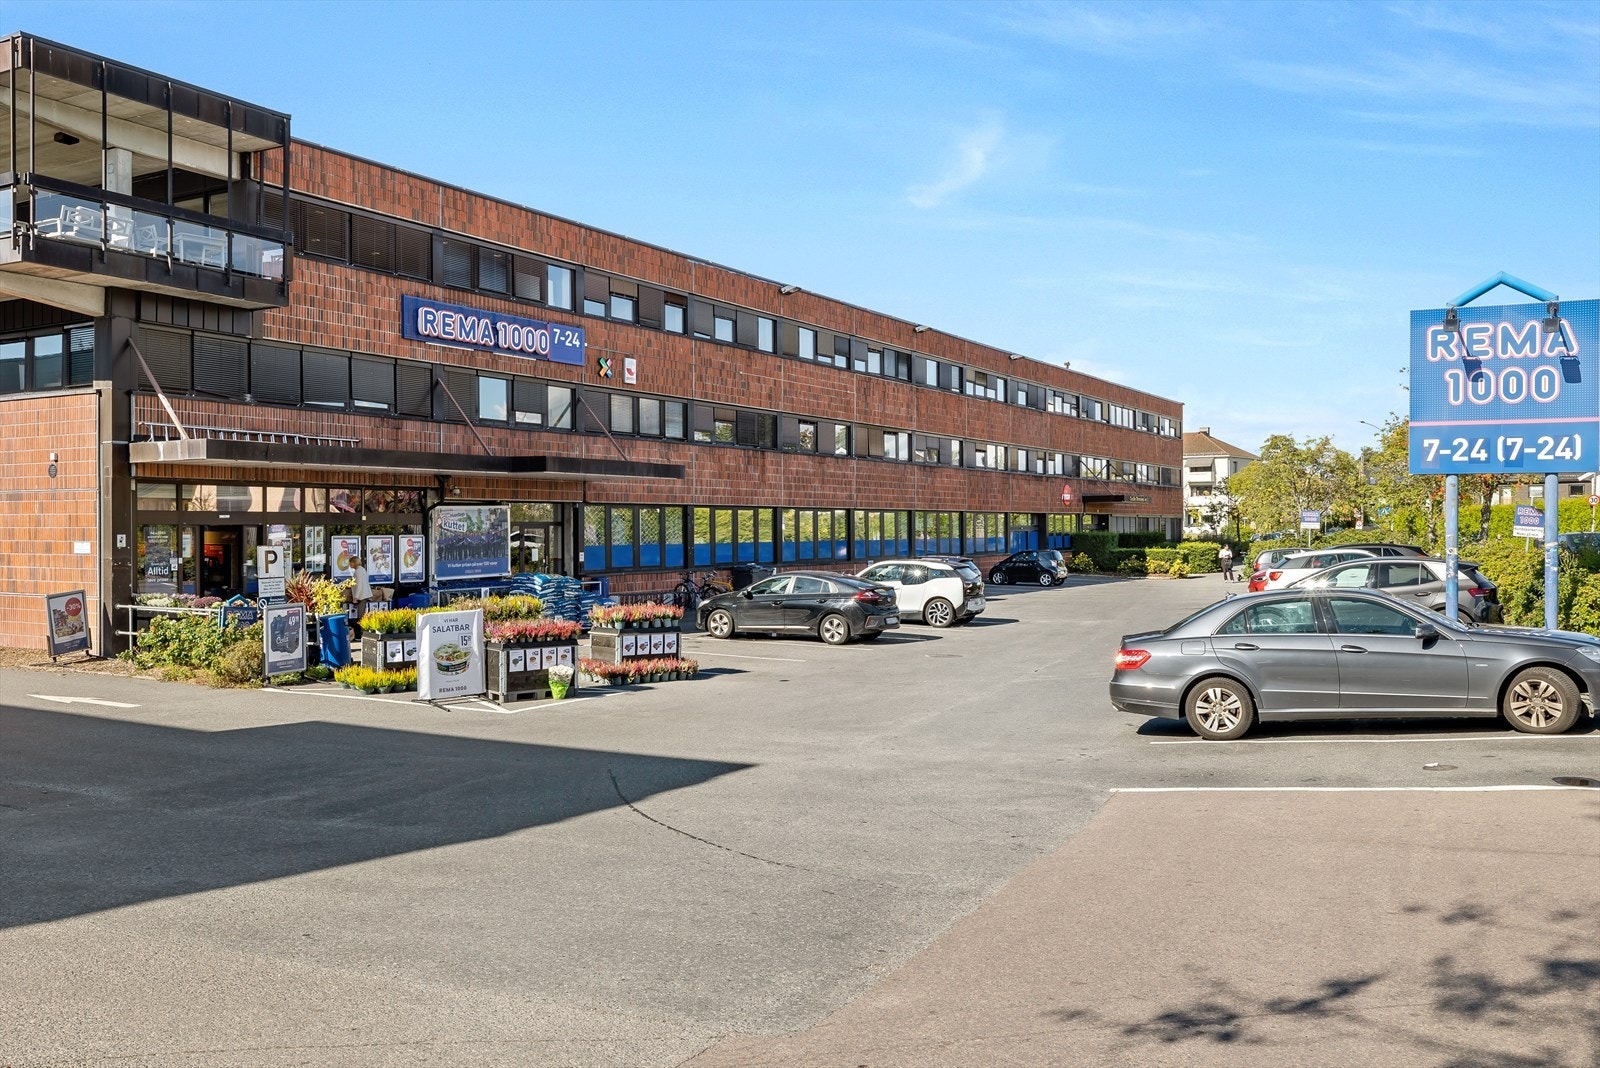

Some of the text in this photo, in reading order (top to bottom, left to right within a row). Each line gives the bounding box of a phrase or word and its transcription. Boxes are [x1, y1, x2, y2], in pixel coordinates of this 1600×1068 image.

[419, 307, 580, 355] REMA 1000 7-24
[1427, 319, 1580, 361] REMA
[1444, 365, 1561, 406] 1000
[1423, 433, 1582, 462] 7-24 (7-24)
[443, 519, 466, 531] kuttet
[1519, 516, 1540, 525] 1000
[147, 567, 169, 576] Alltid
[264, 550, 278, 574] P
[432, 623, 470, 633] SALATBAR
